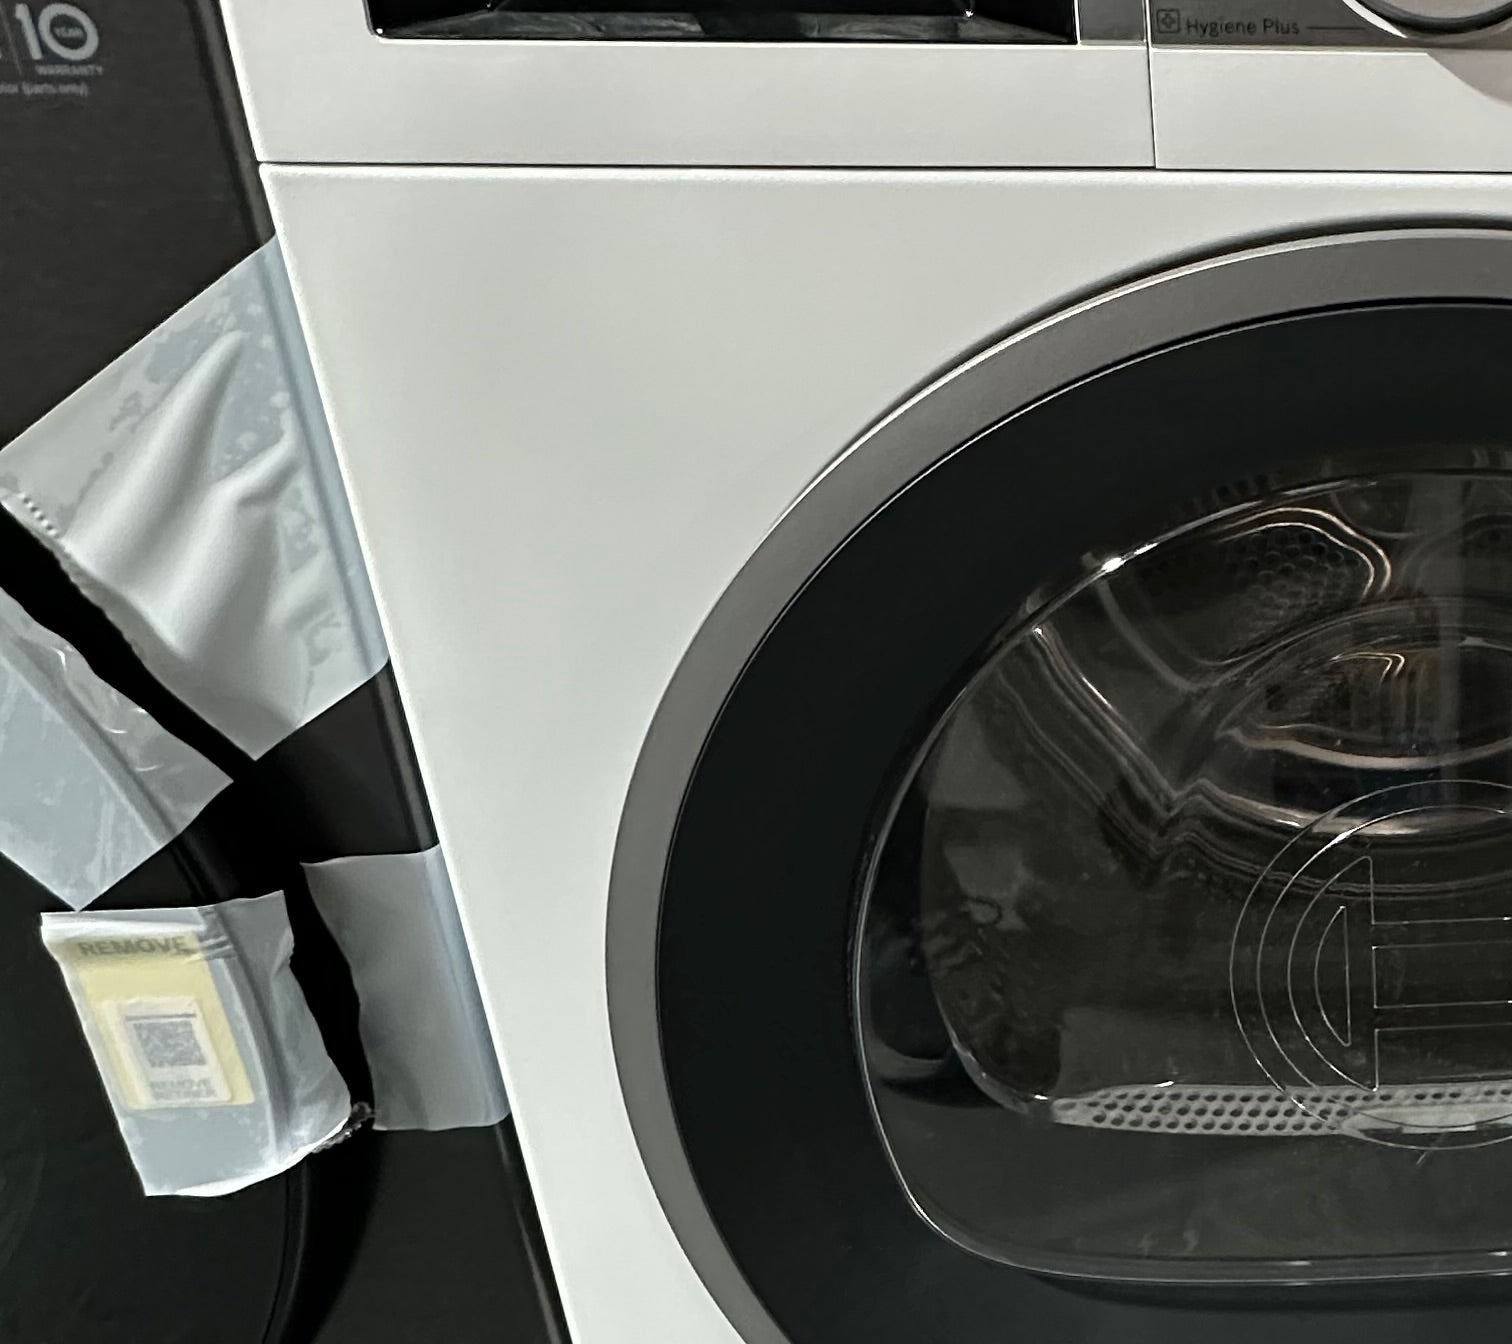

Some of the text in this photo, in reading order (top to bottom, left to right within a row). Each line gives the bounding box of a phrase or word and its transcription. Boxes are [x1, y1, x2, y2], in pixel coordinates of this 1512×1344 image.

[15, 3, 99, 61] 10
[1186, 18, 1300, 38] Hygiene Plus
[78, 935, 193, 957] REMOVE
